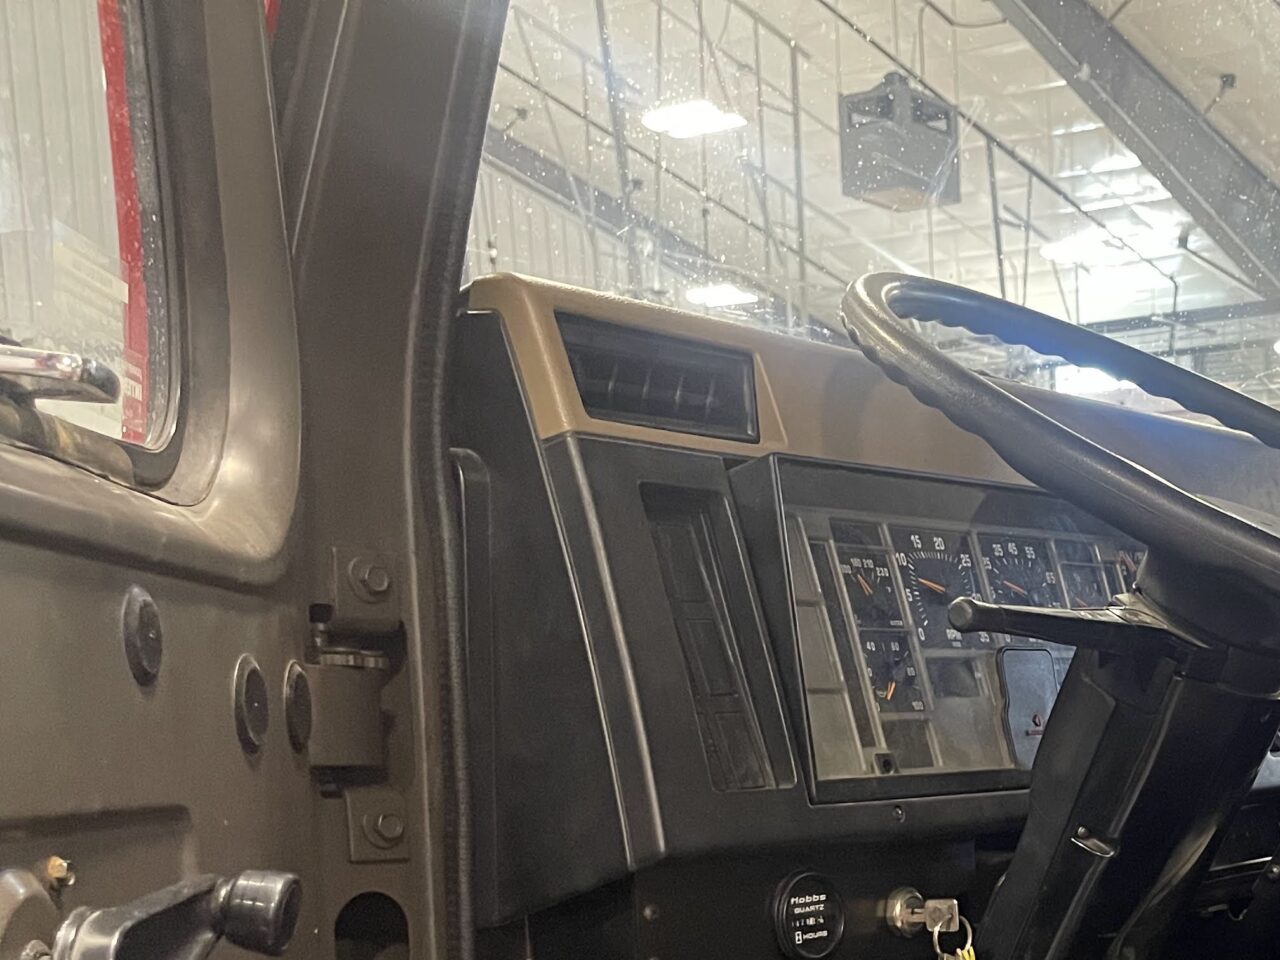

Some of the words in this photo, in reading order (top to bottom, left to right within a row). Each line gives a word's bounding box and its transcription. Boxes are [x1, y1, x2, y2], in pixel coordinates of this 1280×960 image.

[911, 535, 922, 548] 15
[934, 537, 945, 550] 20
[992, 544, 1004, 557] 35
[1025, 546, 1036, 559] 55
[896, 552, 907, 566] 10
[960, 554, 972, 567] 25
[918, 628, 925, 640] 0
[791, 894, 827, 905] Hobbs
[794, 904, 824, 914] QUARTZ
[802, 930, 828, 940] HOURS
